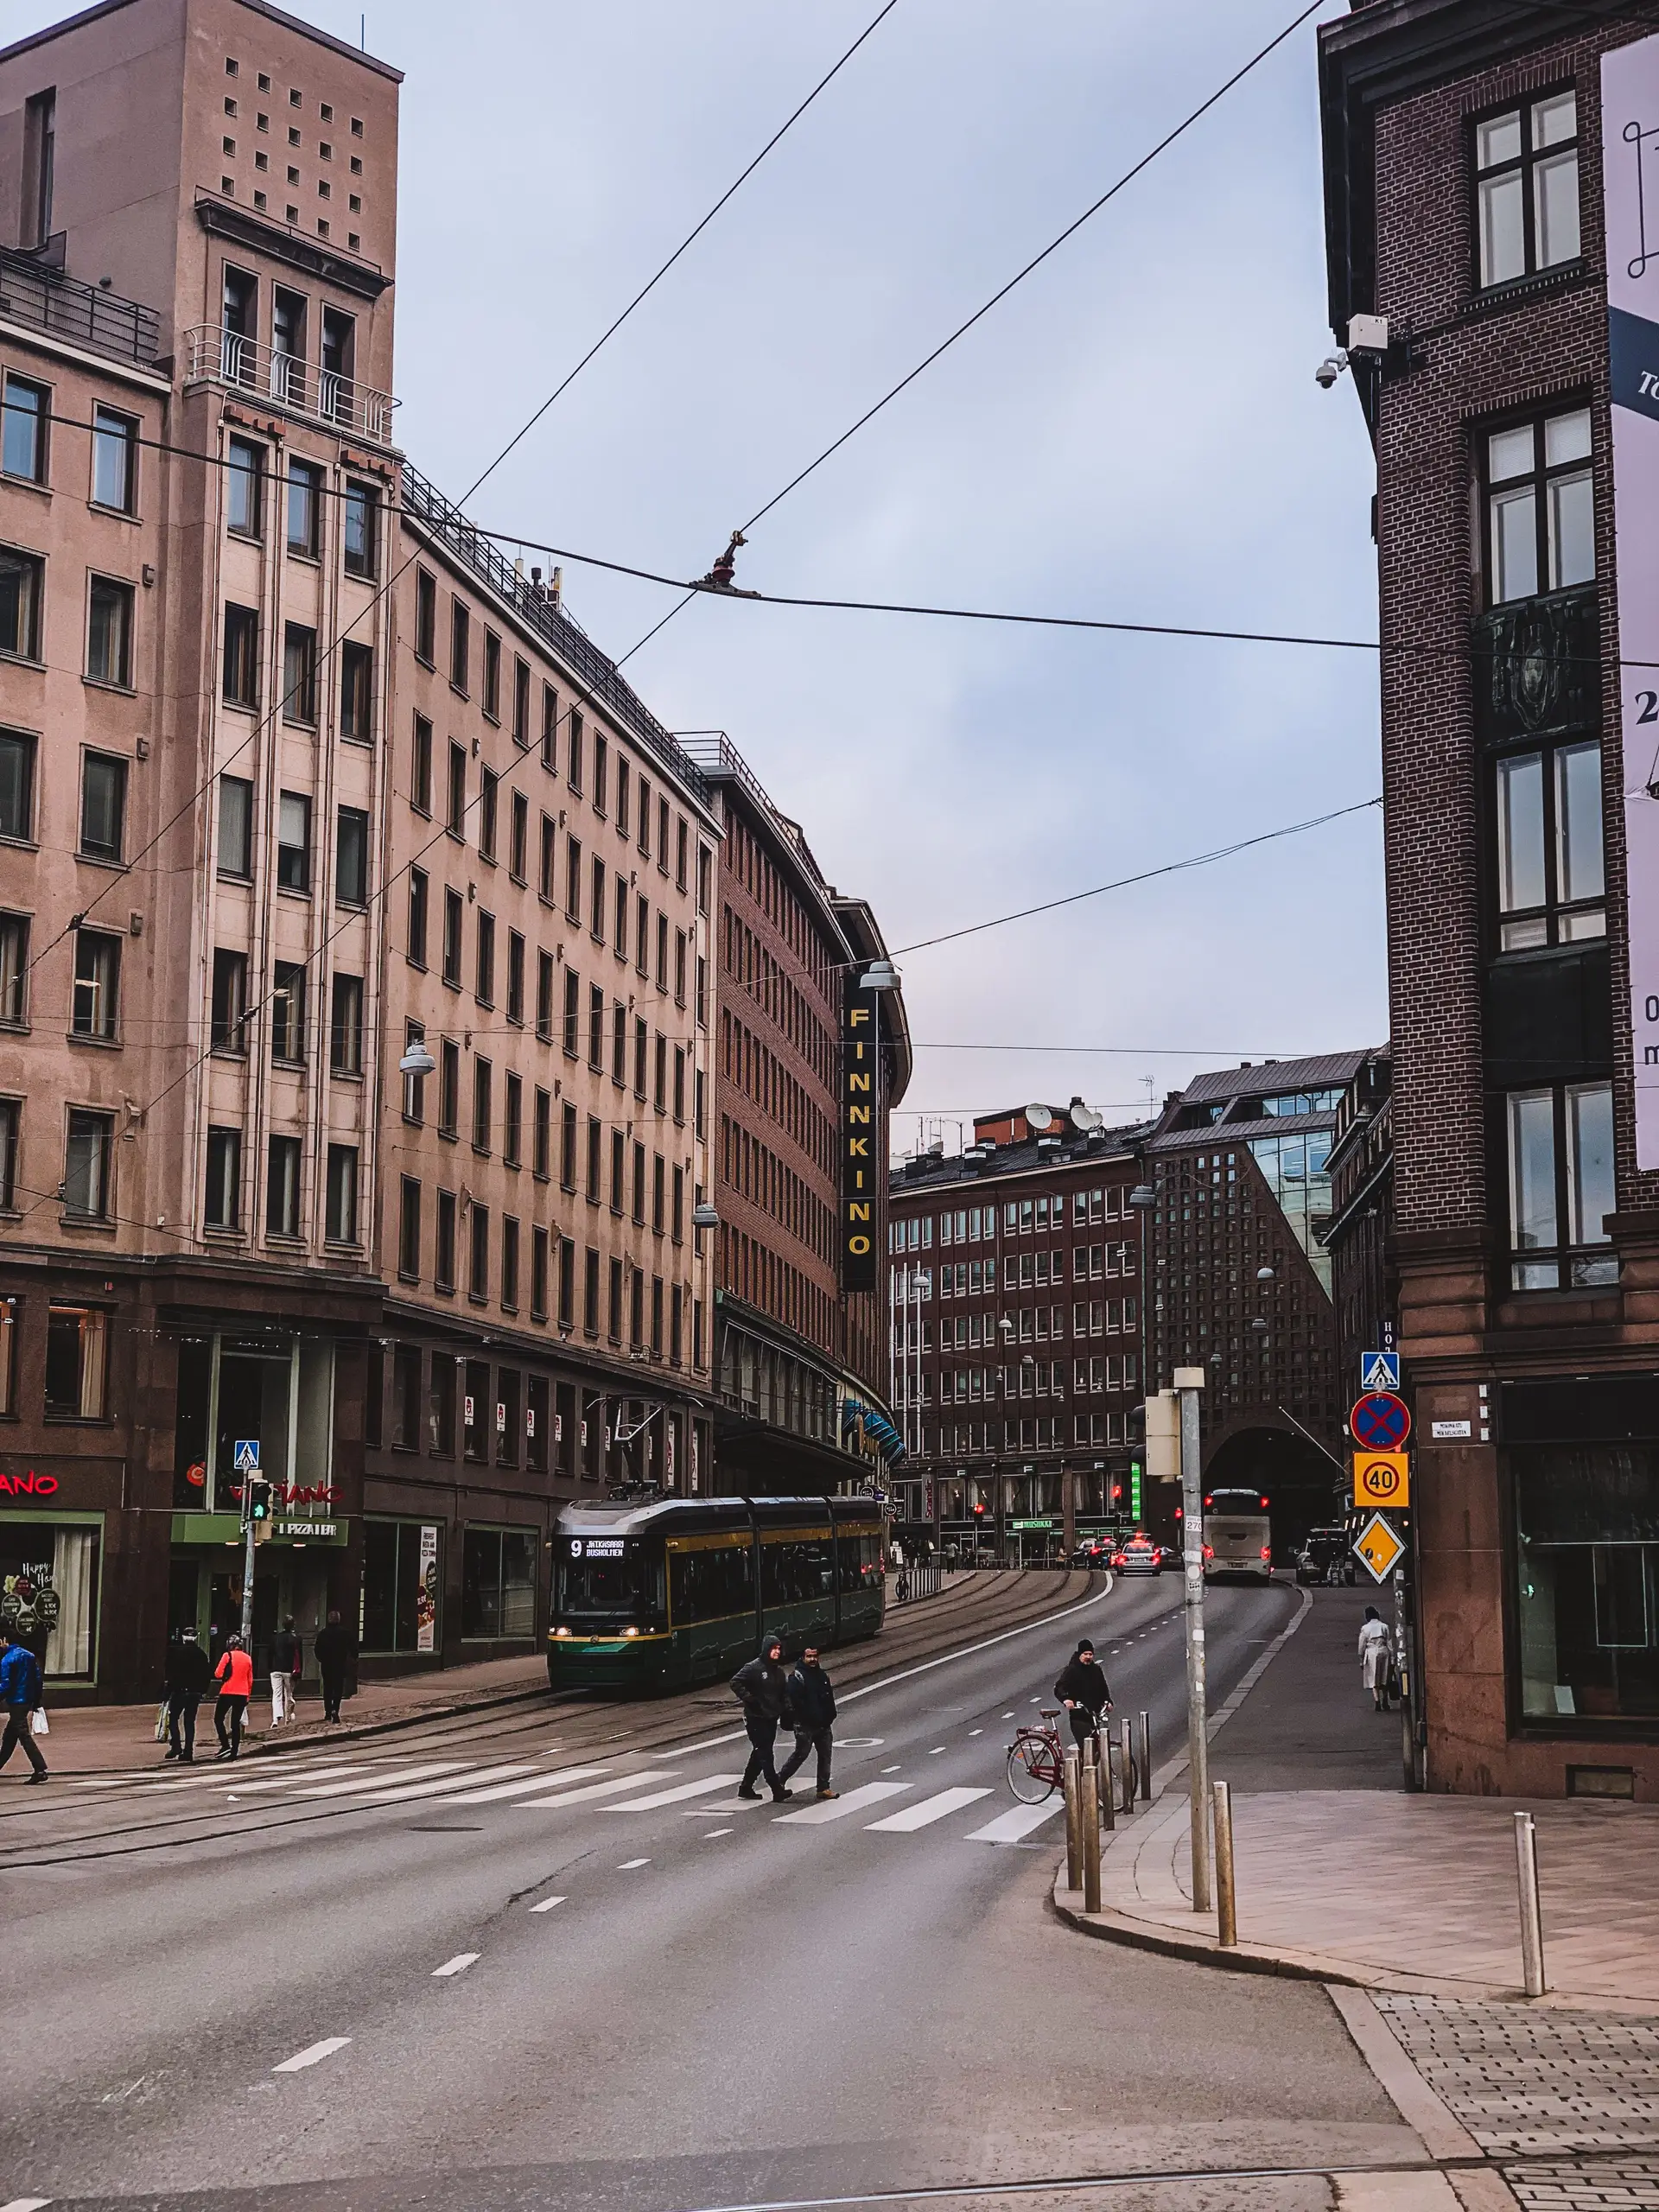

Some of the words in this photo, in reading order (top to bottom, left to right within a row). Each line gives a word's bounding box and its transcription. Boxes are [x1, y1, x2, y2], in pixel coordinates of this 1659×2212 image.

[849, 1008, 870, 1255] FINNKINO
[1369, 1471, 1393, 1489] 40
[287, 1522, 315, 1535] PIZZA
[570, 1540, 582, 1557] 9
[22, 1562, 51, 1578] Happy
